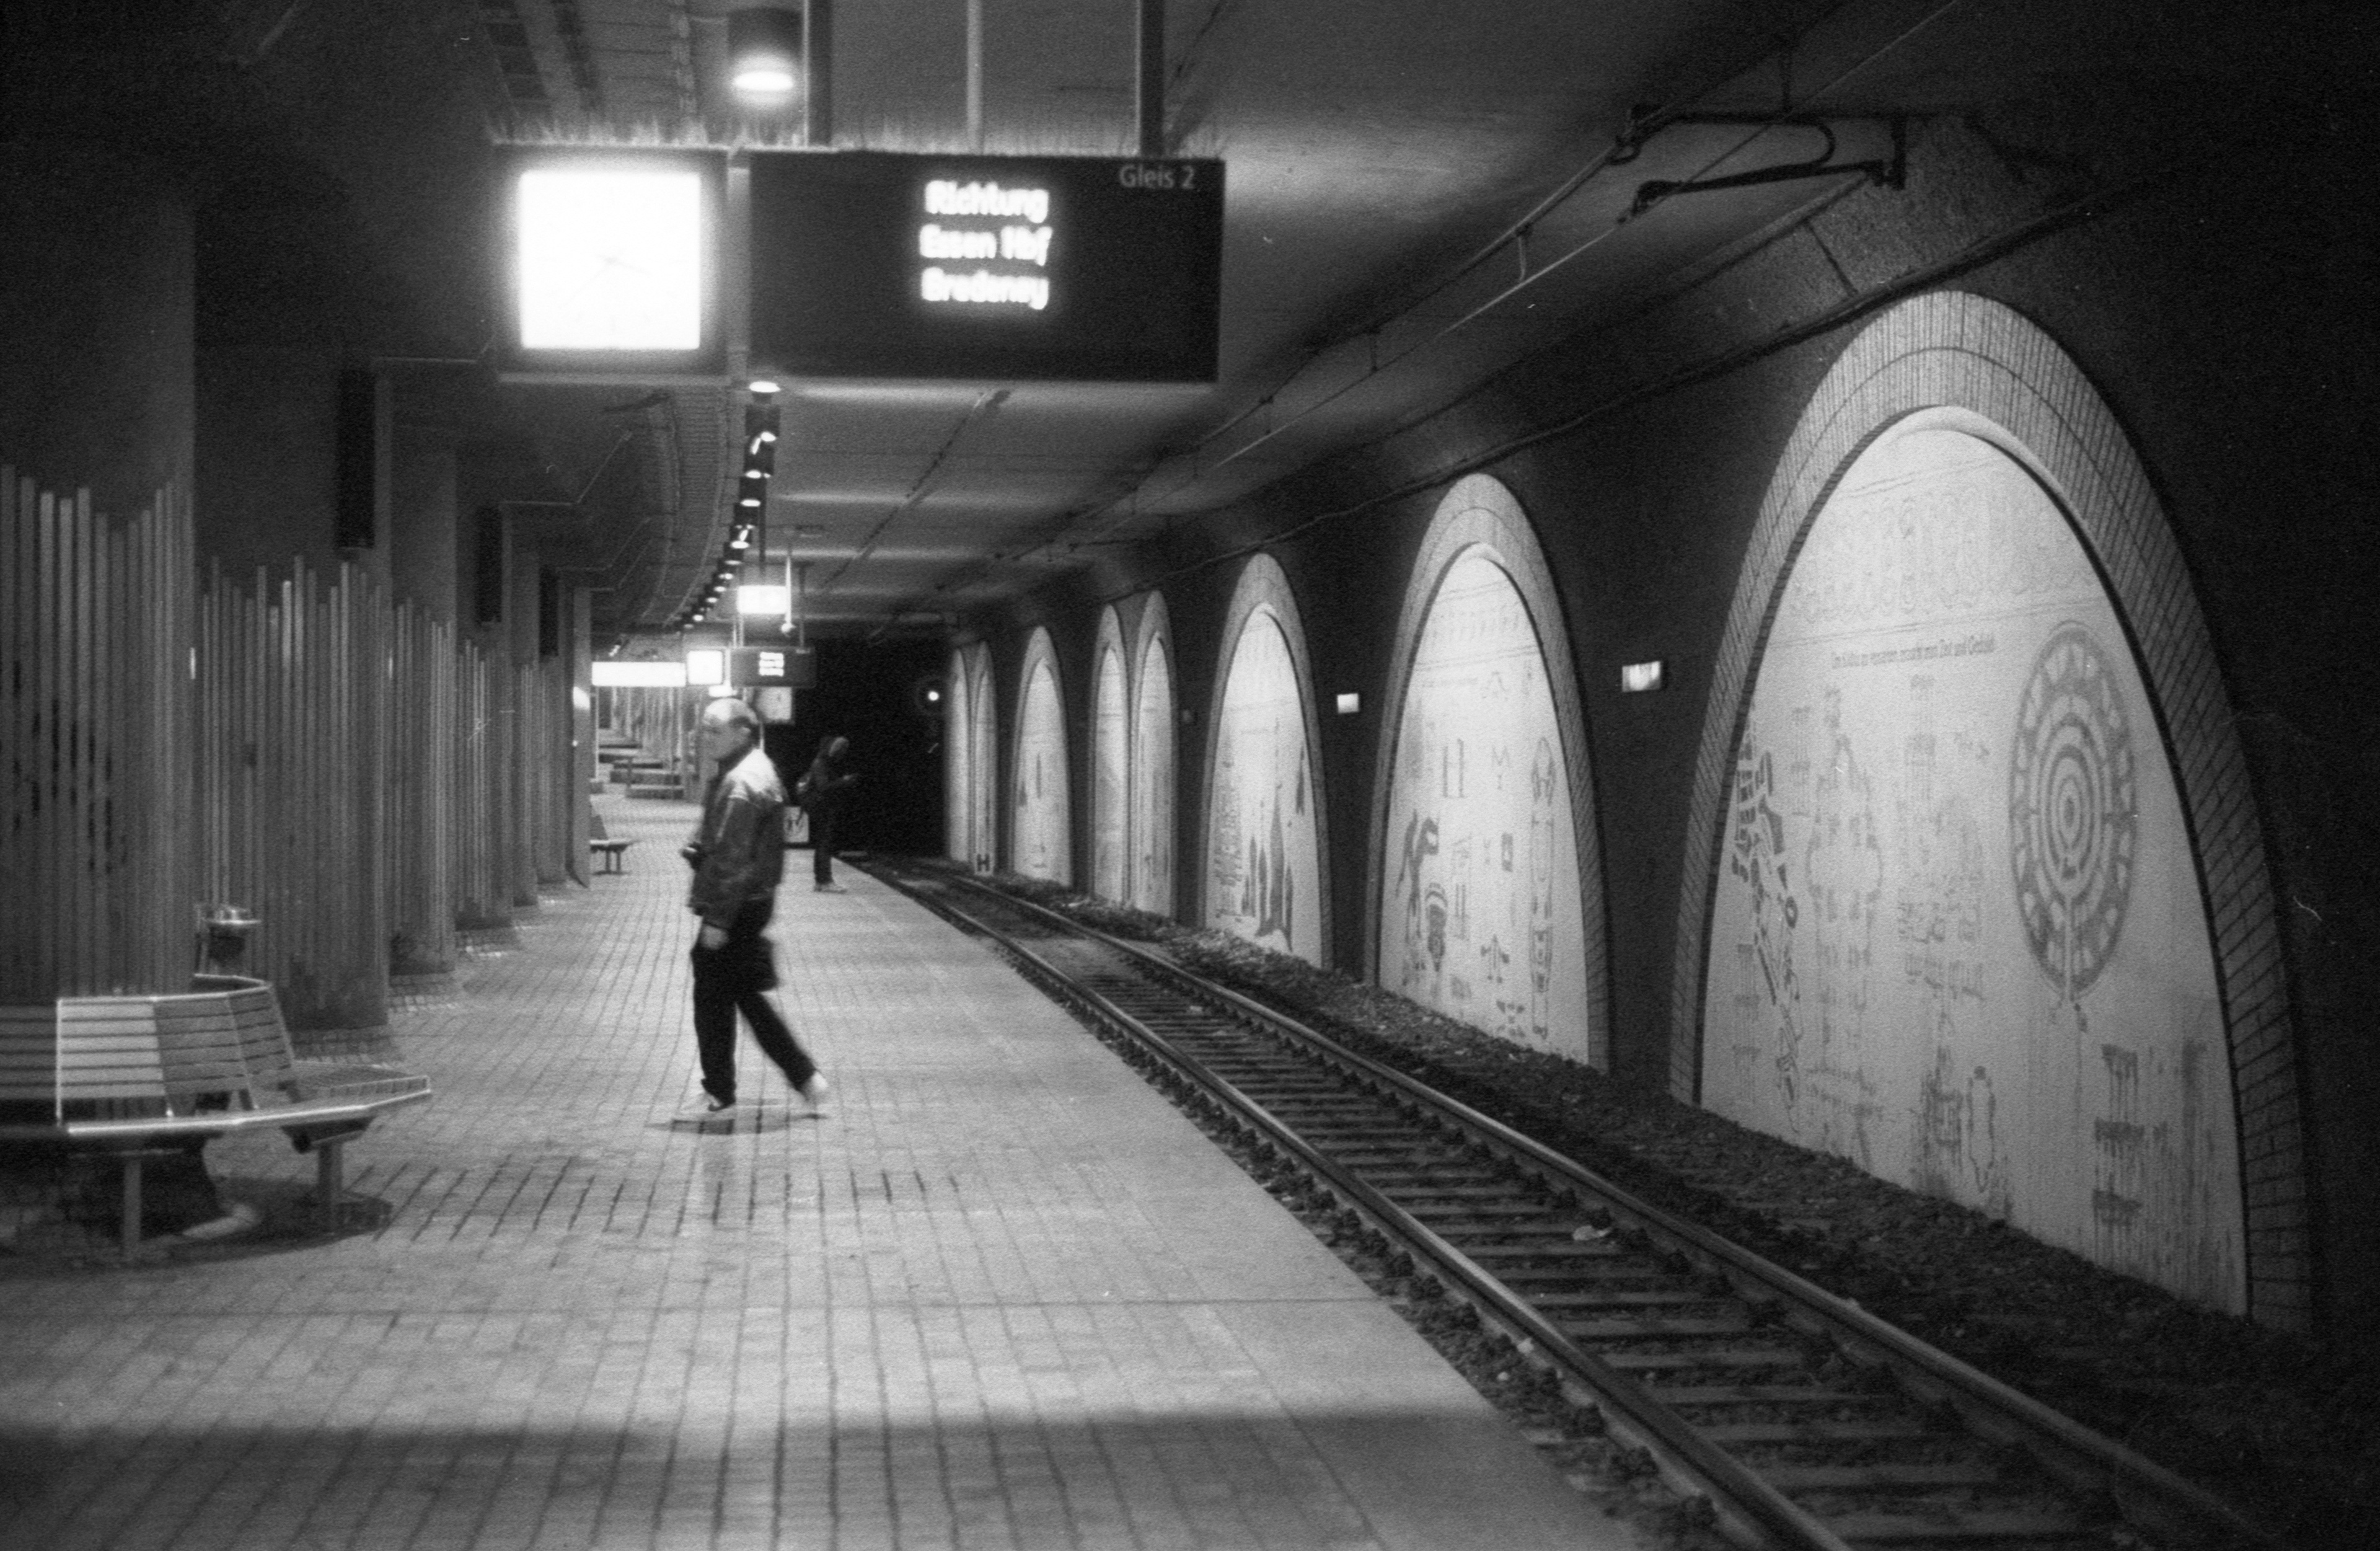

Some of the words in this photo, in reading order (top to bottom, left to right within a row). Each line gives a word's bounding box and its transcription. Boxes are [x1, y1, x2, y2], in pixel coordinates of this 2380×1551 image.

[1119, 164, 1175, 189] Gleis
[1181, 164, 1195, 189] 2
[924, 179, 1049, 224] Richtung
